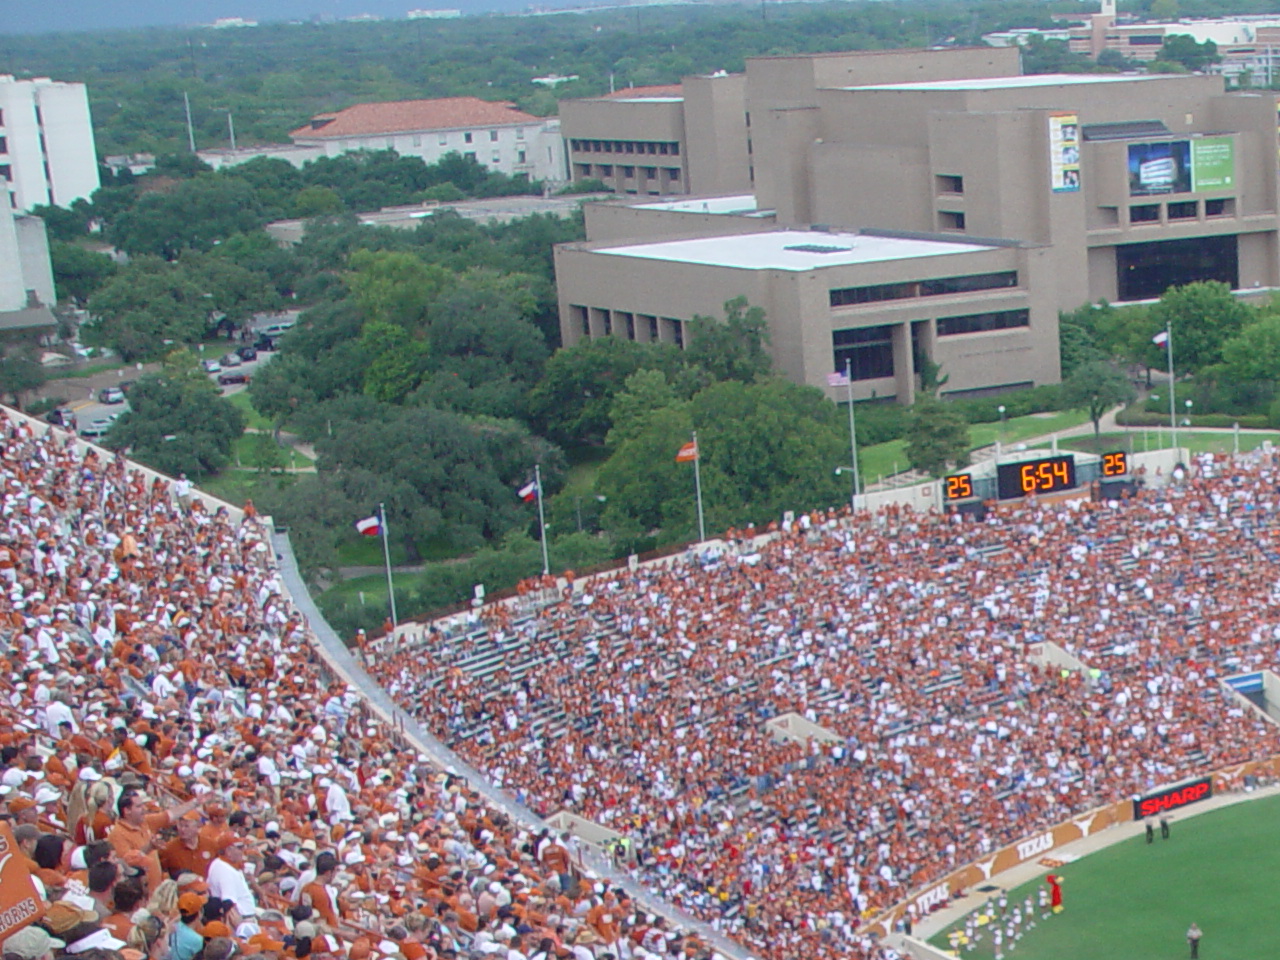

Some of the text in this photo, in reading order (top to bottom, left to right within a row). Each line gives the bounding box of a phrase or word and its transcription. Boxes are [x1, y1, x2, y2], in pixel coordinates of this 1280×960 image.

[1021, 461, 1069, 492] 6:54
[1104, 453, 1126, 476] 25
[947, 475, 971, 498] 25
[1140, 782, 1210, 816] SHARP
[1017, 831, 1055, 860] TEXAS
[916, 881, 950, 914] TEXAS
